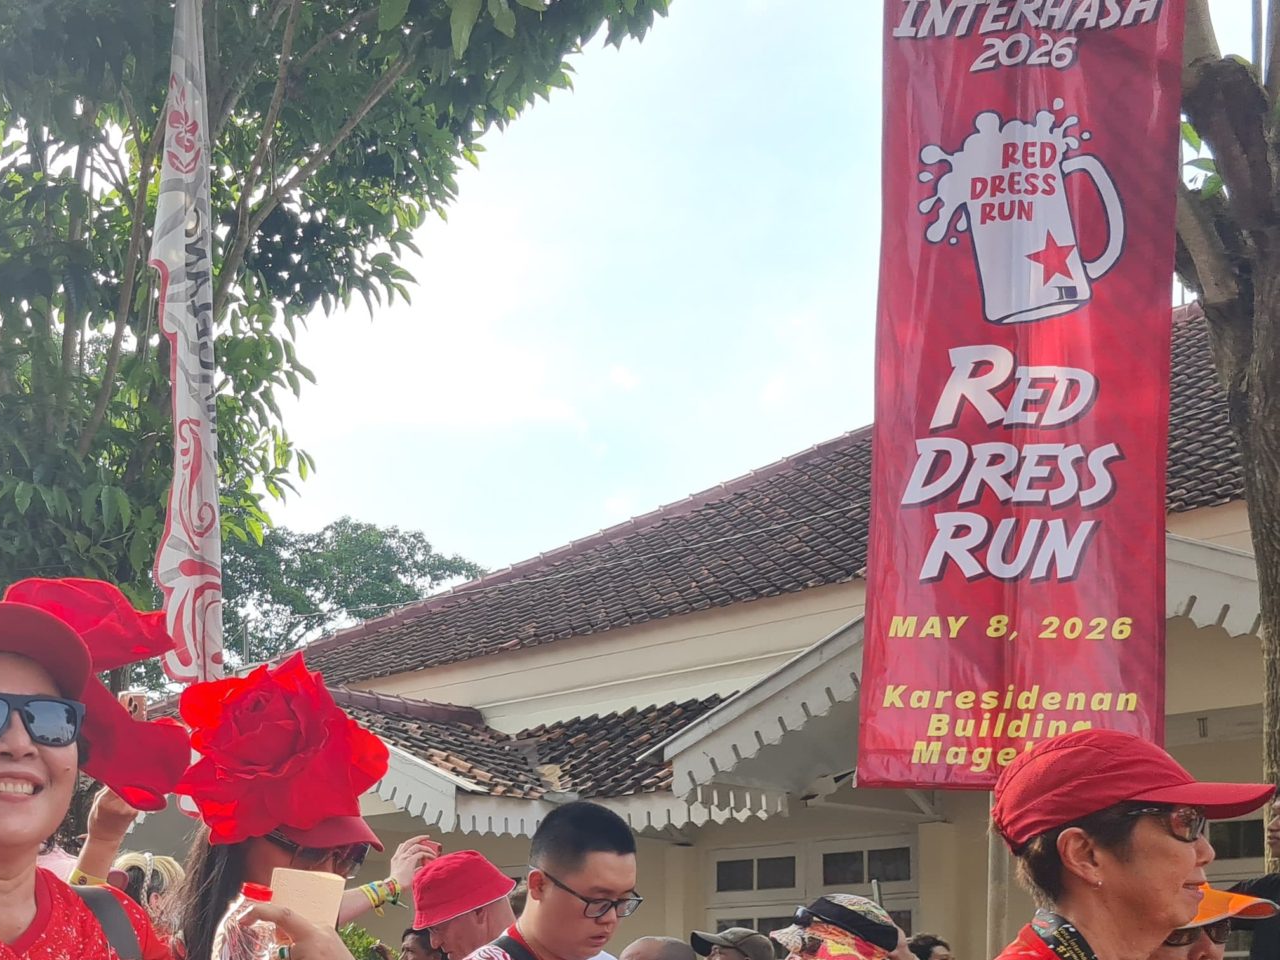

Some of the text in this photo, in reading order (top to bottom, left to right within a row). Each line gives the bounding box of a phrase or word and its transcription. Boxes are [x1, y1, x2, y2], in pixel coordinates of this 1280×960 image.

[894, 0, 1165, 38] INTERHASH
[971, 33, 1078, 72] 2026
[1002, 141, 1057, 169] RED
[971, 173, 1056, 200] DRESS
[980, 200, 1033, 225] RUN
[930, 344, 1096, 430] RED
[900, 437, 1121, 507] DRESS
[919, 511, 1096, 580] RUN
[889, 615, 1133, 641] MAY 8, 2026
[882, 685, 1138, 712] Karesidenan
